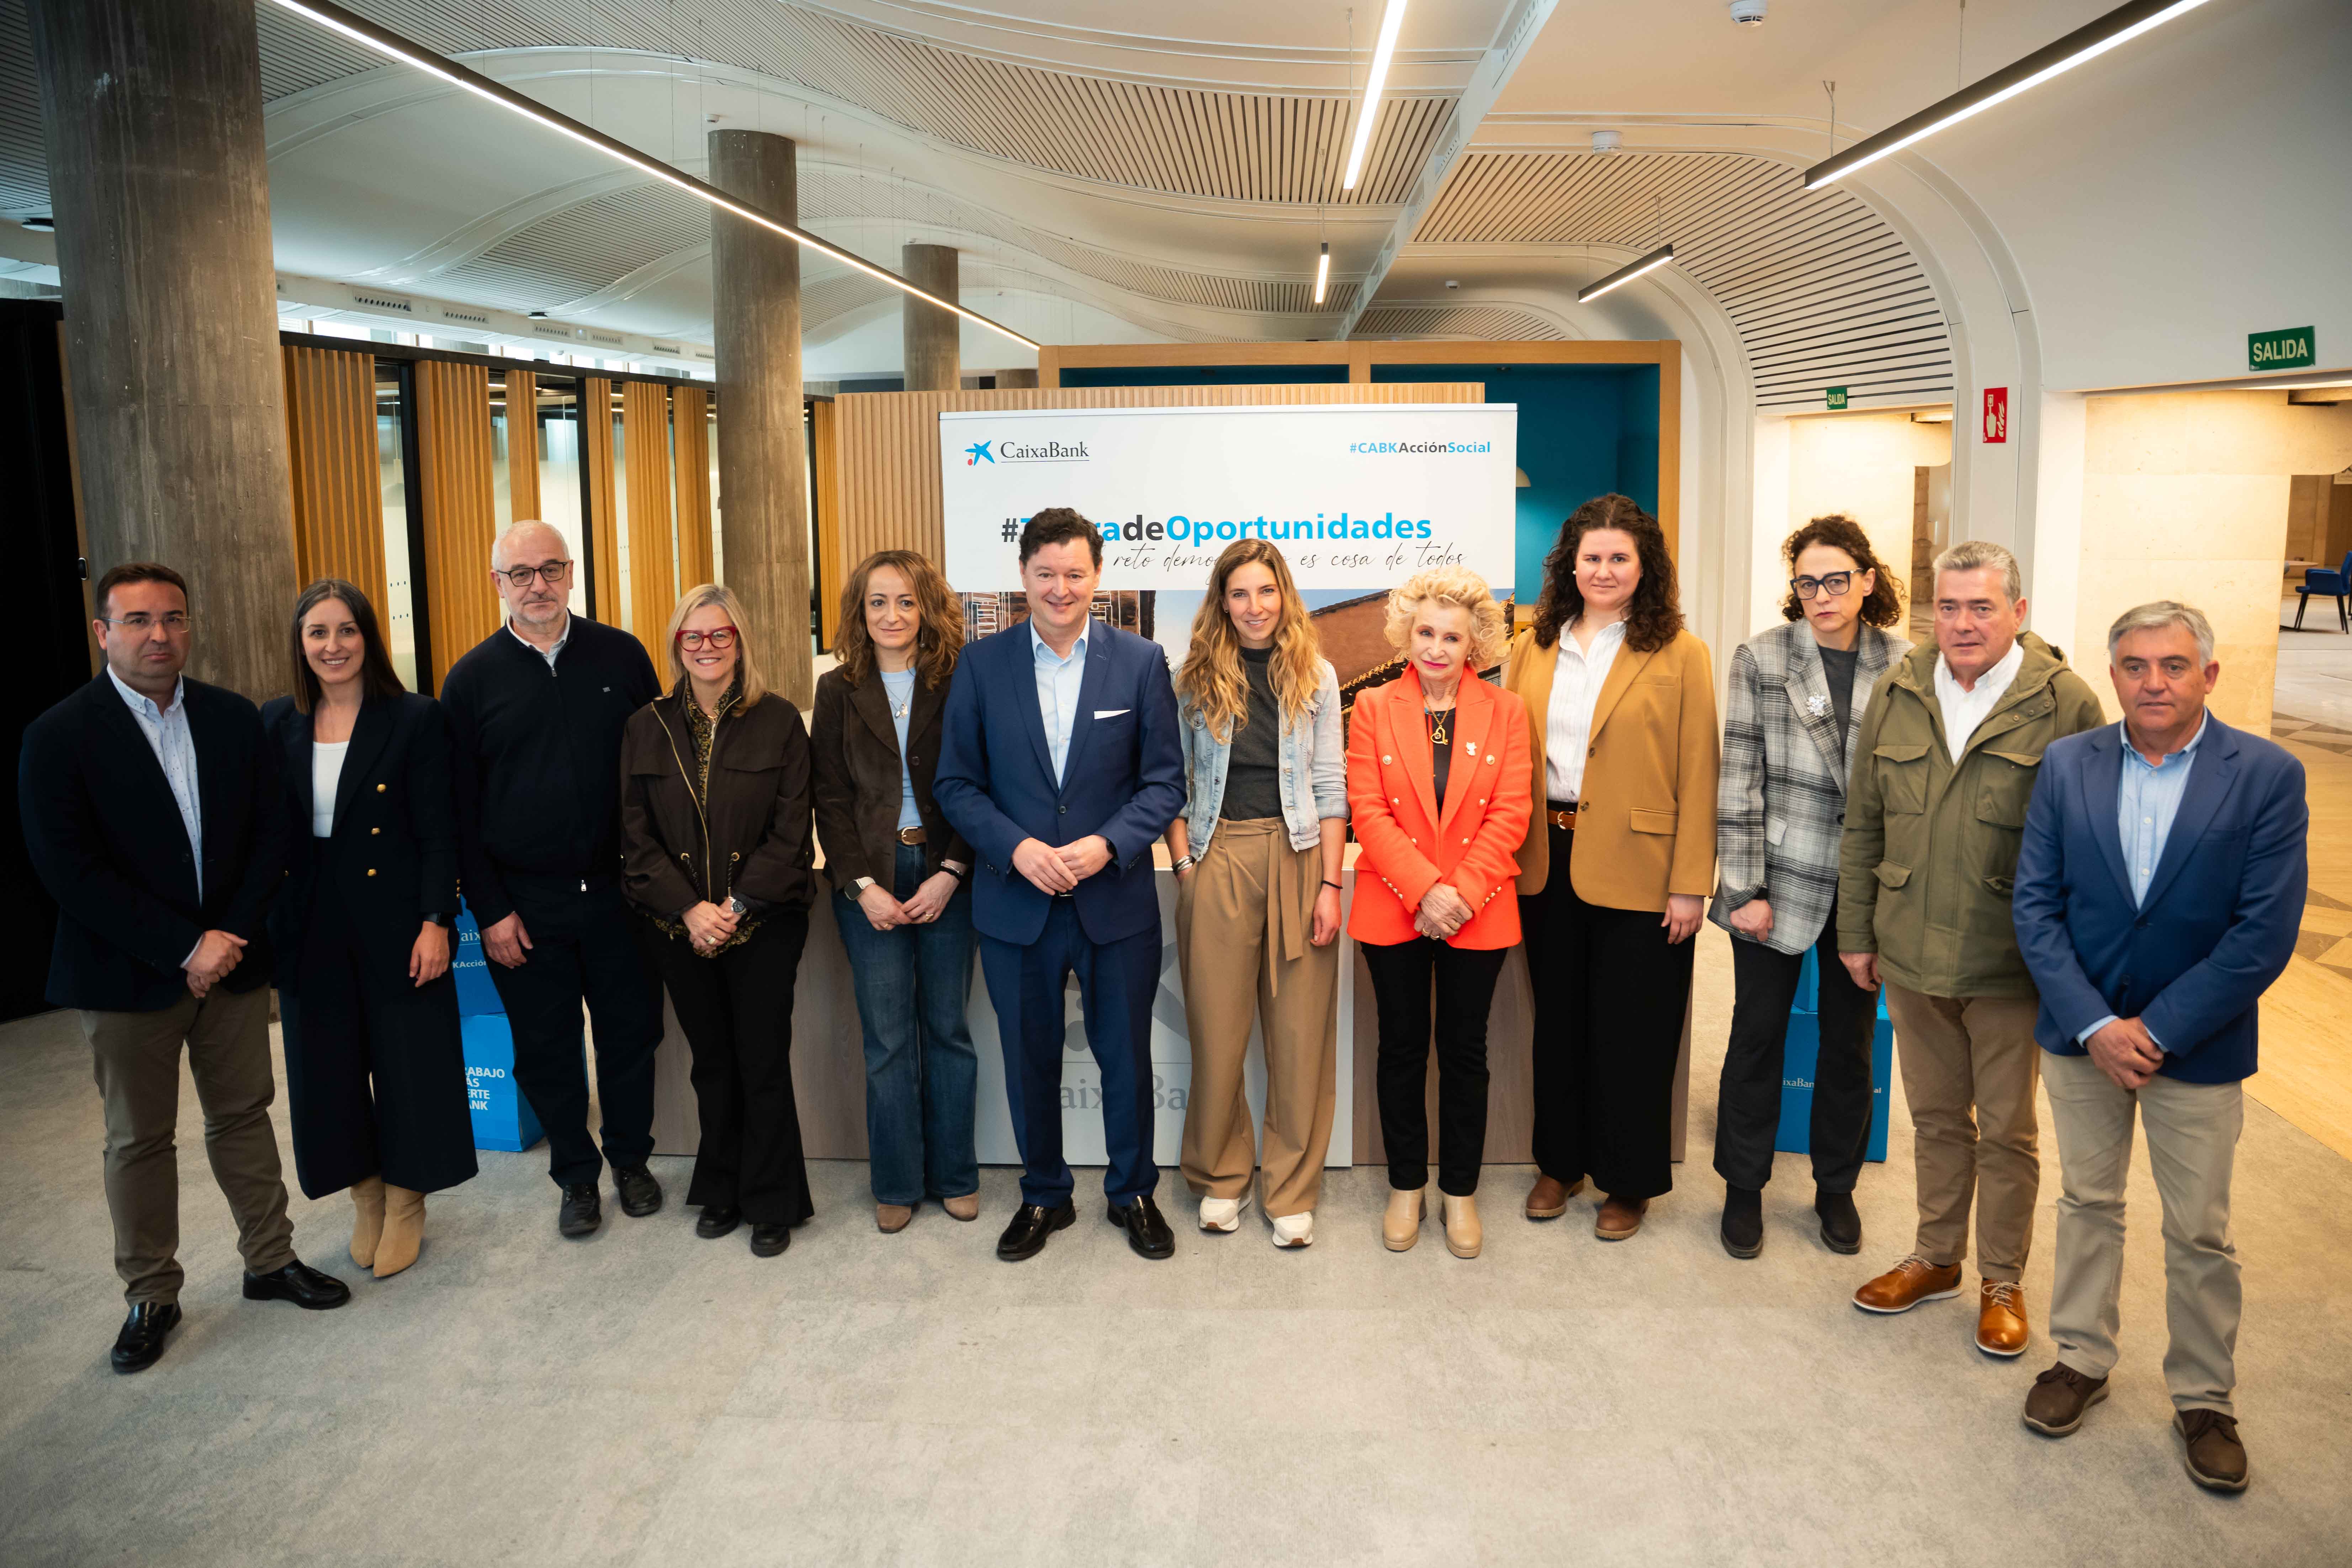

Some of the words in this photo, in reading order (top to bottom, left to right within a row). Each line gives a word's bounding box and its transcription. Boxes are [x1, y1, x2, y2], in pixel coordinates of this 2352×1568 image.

[2253, 338, 2308, 362] SALIDA
[1828, 393, 1845, 405] SALIDA
[1000, 441, 1089, 458] CaixaBank
[1350, 441, 1490, 453] #CABKAcciónSocial
[1113, 543, 1155, 569] reto
[1300, 553, 1322, 568] es
[1331, 553, 1377, 568] cosa
[1386, 542, 1410, 571] de
[1415, 541, 1468, 568] todos
[465, 1066, 505, 1078] ABAJO
[466, 1076, 480, 1087] ÁS
